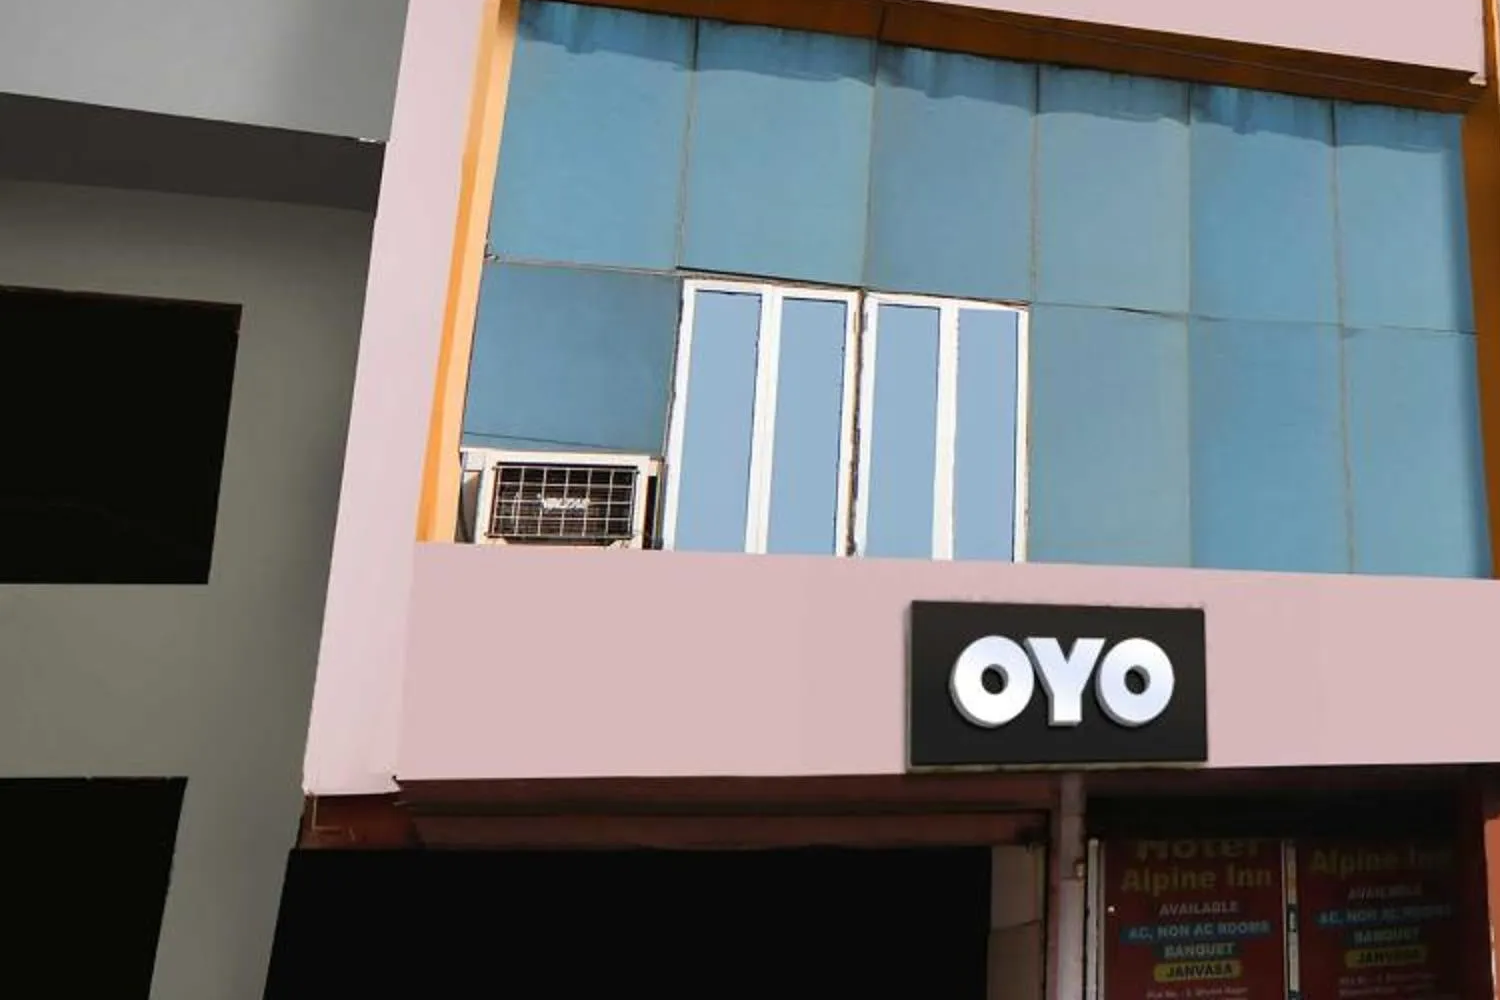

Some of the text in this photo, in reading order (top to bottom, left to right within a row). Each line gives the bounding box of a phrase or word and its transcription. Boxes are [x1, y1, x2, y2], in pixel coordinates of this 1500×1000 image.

[950, 634, 1176, 728] OYO
[1121, 863, 1272, 897] Alpine Inn
[1158, 900, 1240, 916] AVAILABLE
[1157, 924, 1190, 939] NON
[1193, 923, 1214, 937] AC
[1163, 942, 1236, 959] BANQUET
